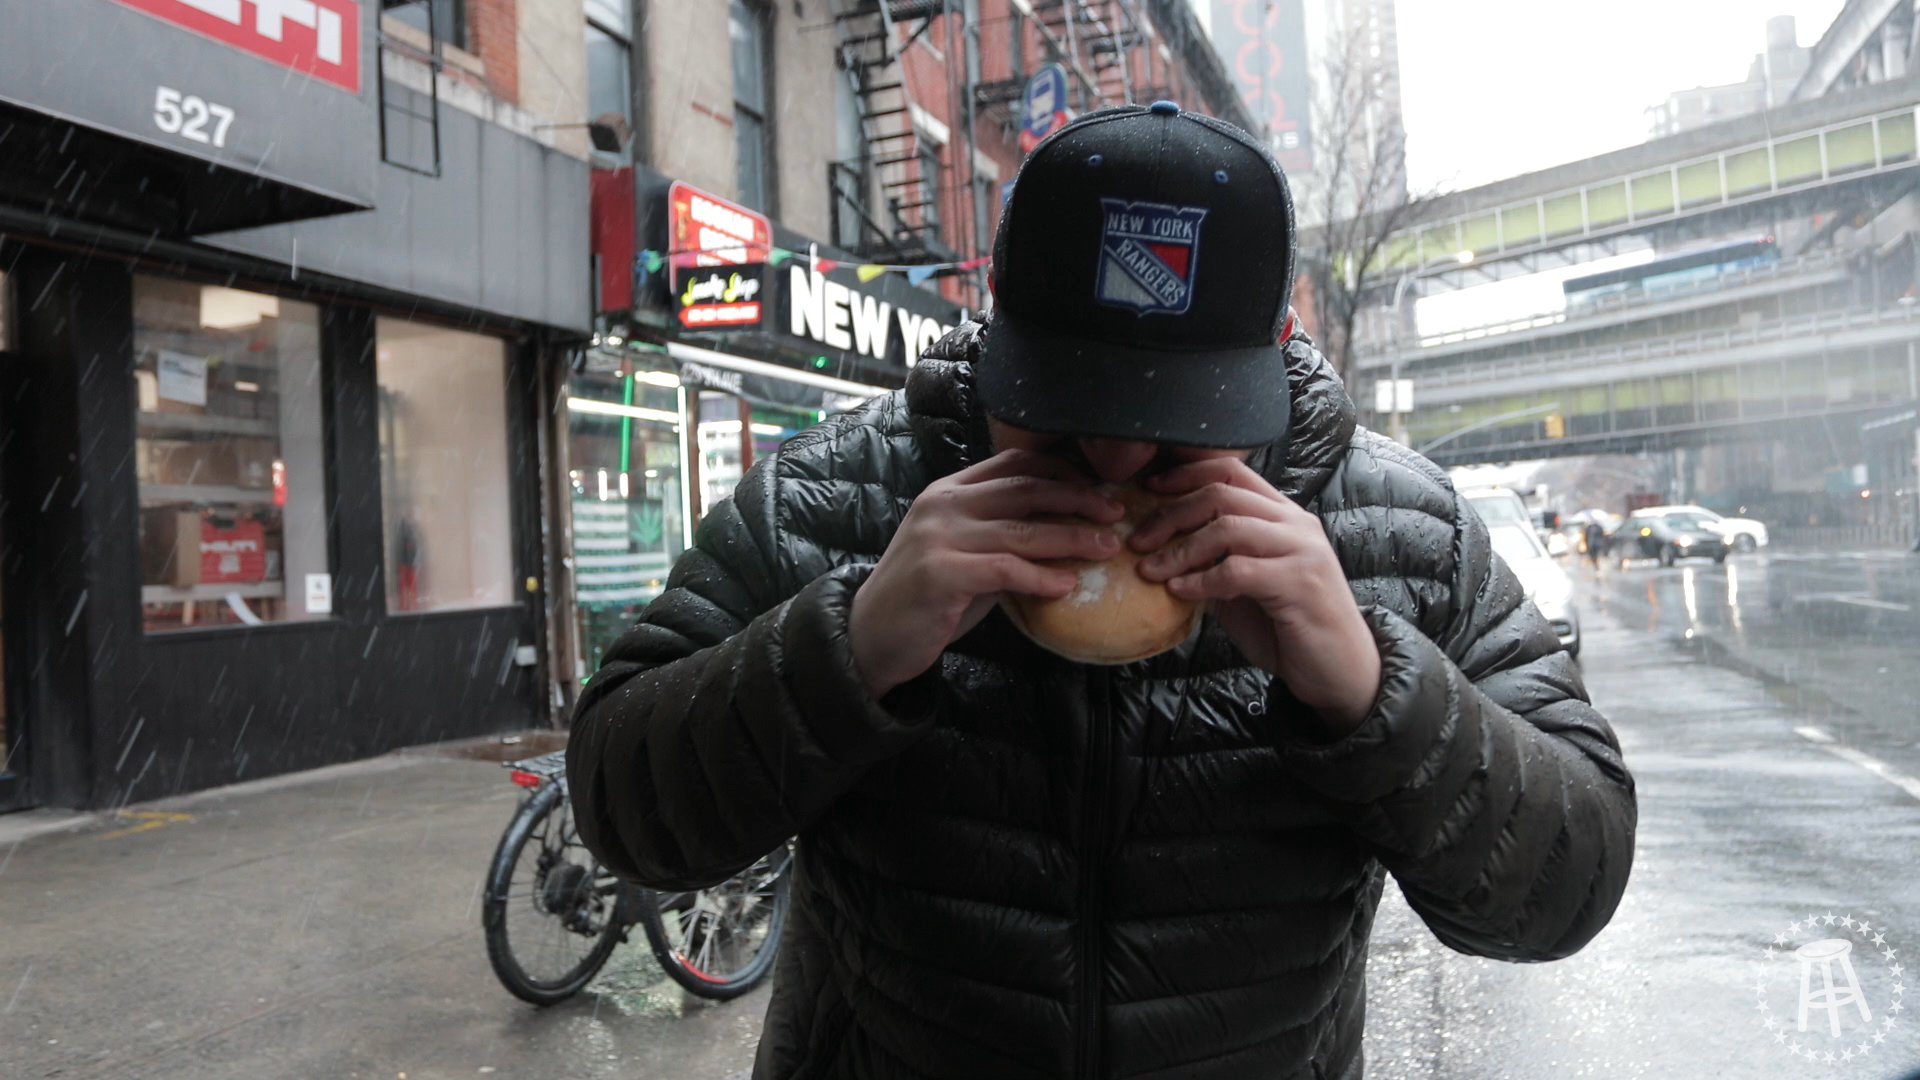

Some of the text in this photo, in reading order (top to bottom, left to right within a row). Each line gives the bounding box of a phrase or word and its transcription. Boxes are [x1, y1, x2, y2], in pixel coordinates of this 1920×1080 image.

[154, 86, 236, 148] 527
[1107, 212, 1194, 238] NEW YORK
[1116, 238, 1185, 305] RANGERS
[790, 243, 890, 360] NEW
[897, 307, 957, 369] YO
